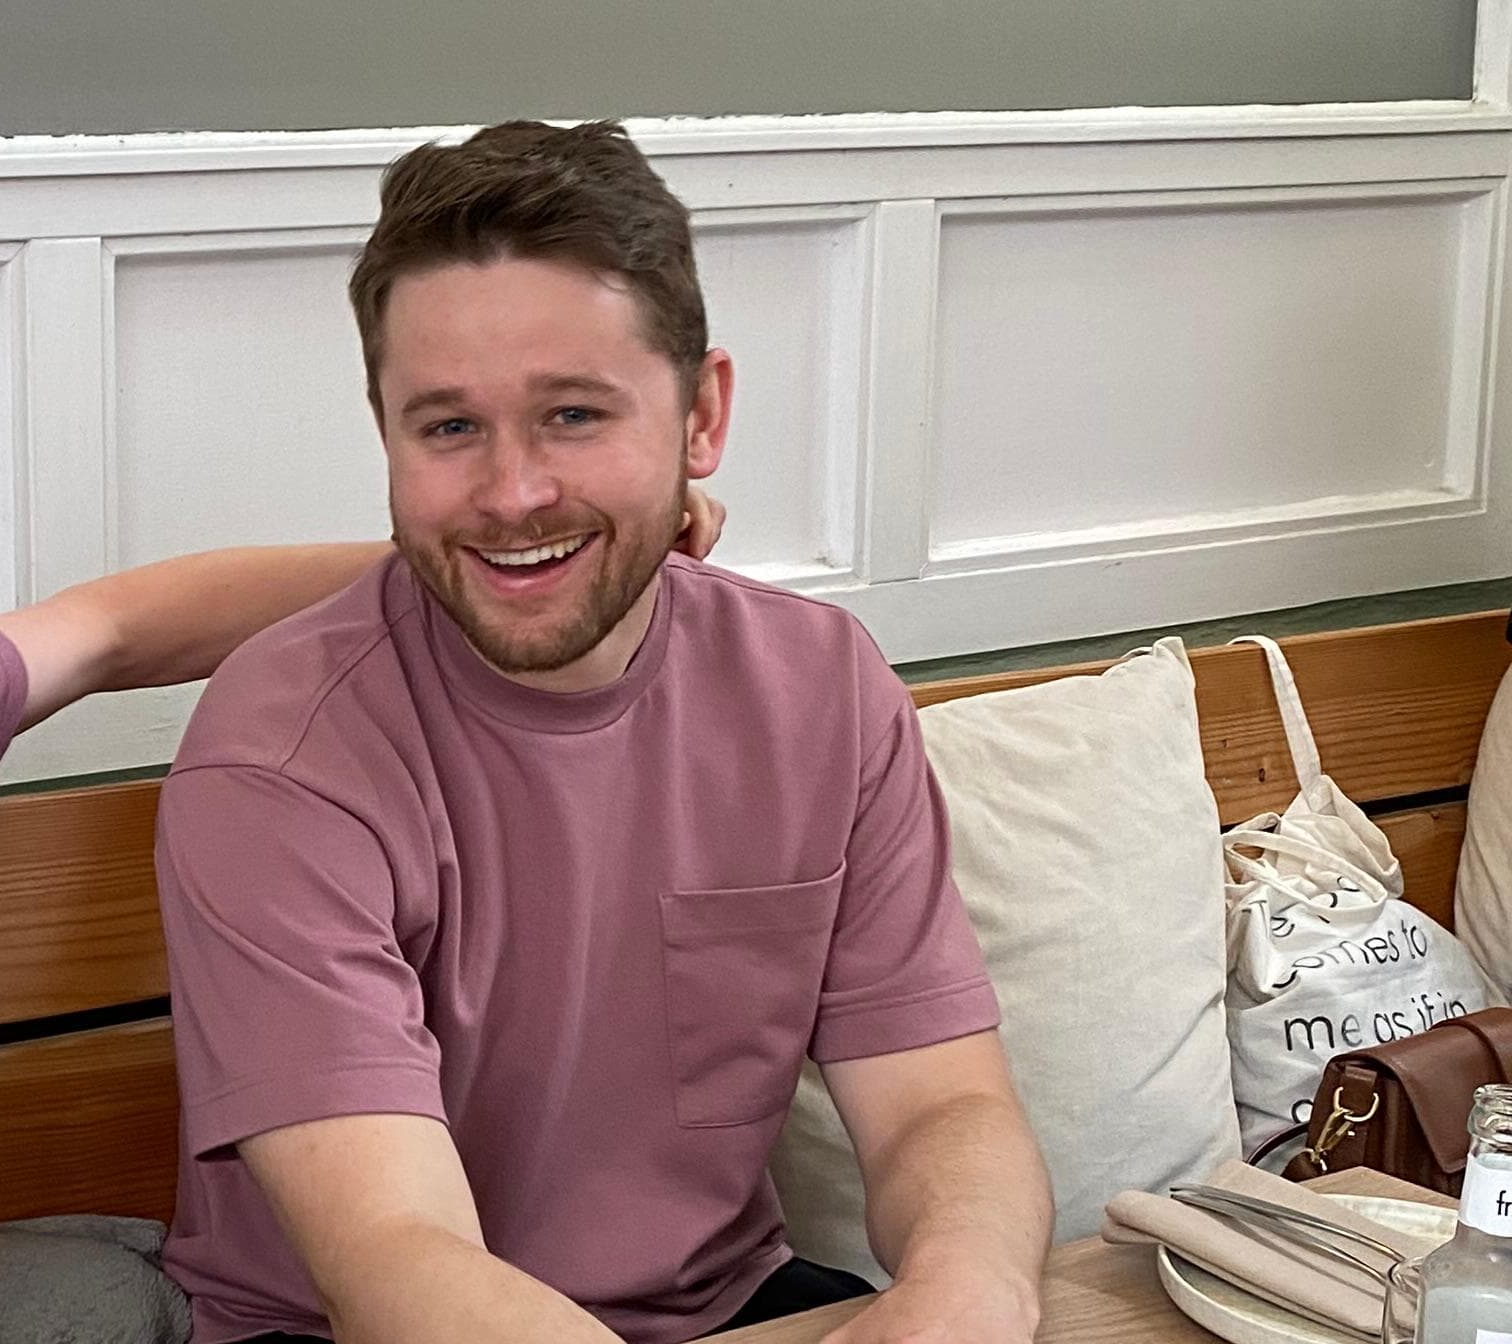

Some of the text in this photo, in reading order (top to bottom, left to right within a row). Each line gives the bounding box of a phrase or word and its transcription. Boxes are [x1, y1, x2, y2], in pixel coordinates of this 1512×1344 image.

[1401, 919, 1428, 960] to
[1284, 1014, 1363, 1052] me
[1373, 1011, 1415, 1045] as
[1411, 993, 1435, 1032] if
